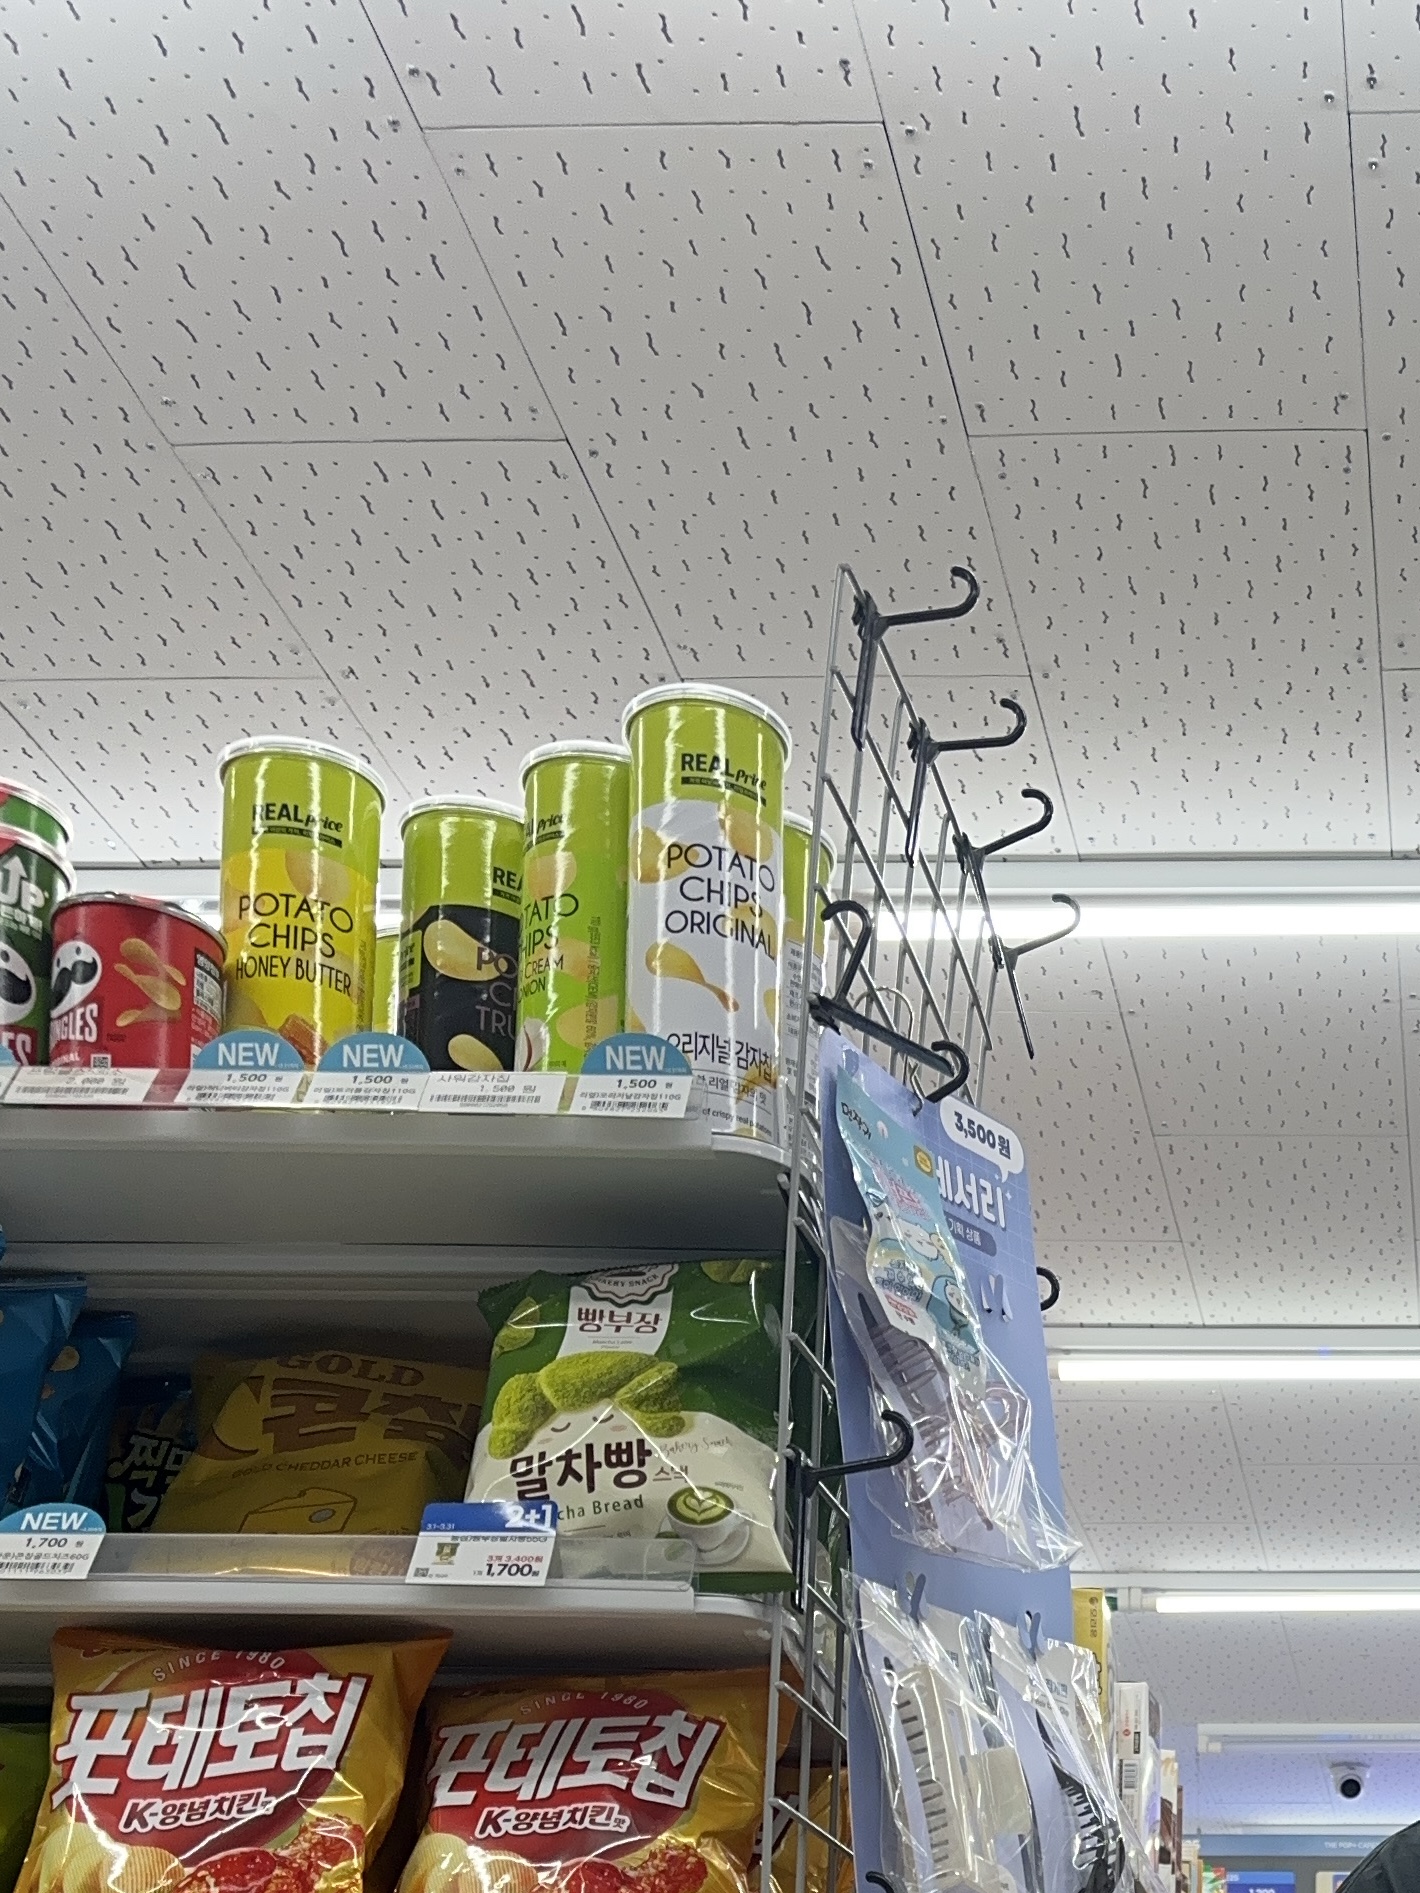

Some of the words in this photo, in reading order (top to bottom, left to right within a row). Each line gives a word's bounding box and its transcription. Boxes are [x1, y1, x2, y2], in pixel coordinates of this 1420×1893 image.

[681, 753, 731, 777] REAL
[252, 803, 304, 824] REAL
[667, 844, 775, 892] POTATO
[680, 876, 763, 918] CHIPS
[239, 893, 354, 934] POTATO
[248, 924, 336, 958] CHIPS
[665, 911, 775, 960] ORIGINAL
[236, 956, 289, 982] HONEY
[295, 960, 352, 996] BUTTER
[218, 1042, 279, 1066] NEW
[343, 1043, 402, 1067] NEW
[606, 1045, 666, 1071] NEW
[734, 1044, 773, 1084] 감자칩
[226, 1073, 268, 1084] 1,500
[352, 1075, 393, 1085] 1,500
[616, 1079, 657, 1089] 1,500
[577, 1308, 662, 1334] 빵부장
[277, 1354, 424, 1387] GOLD
[276, 1456, 352, 1472] CHEDDAR
[354, 1451, 420, 1466] CHEESE
[508, 1438, 653, 1501] 말차빵
[505, 1504, 553, 1530] 2+1
[592, 1494, 645, 1517] Bread
[21, 1512, 88, 1530] NEW
[26, 1537, 68, 1549] 1,700
[152, 1650, 221, 1682] SINCE
